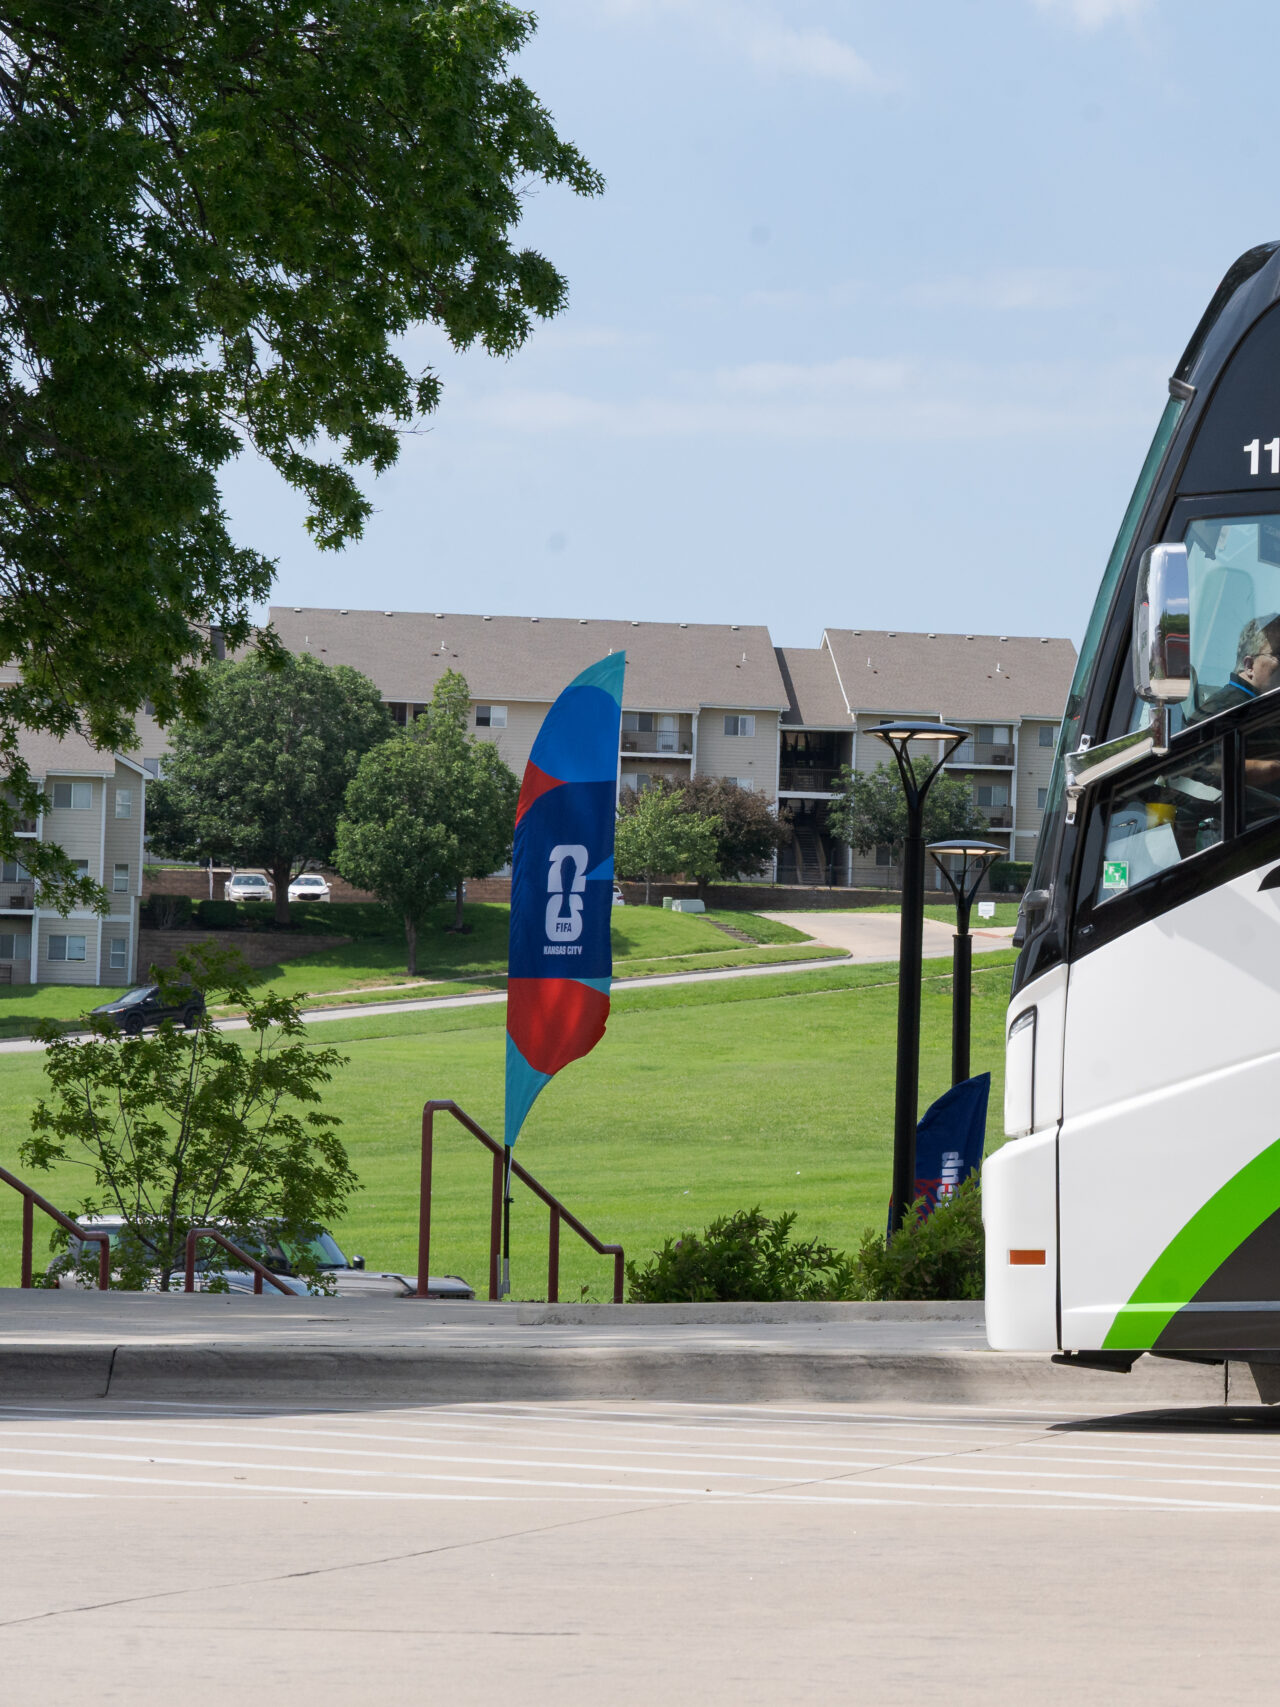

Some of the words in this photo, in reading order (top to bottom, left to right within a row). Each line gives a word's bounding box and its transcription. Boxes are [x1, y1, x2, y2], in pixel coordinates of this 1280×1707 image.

[555, 922, 573, 933] FIFA
[543, 946, 567, 955] KANSAS
[567, 946, 583, 955] CITY
